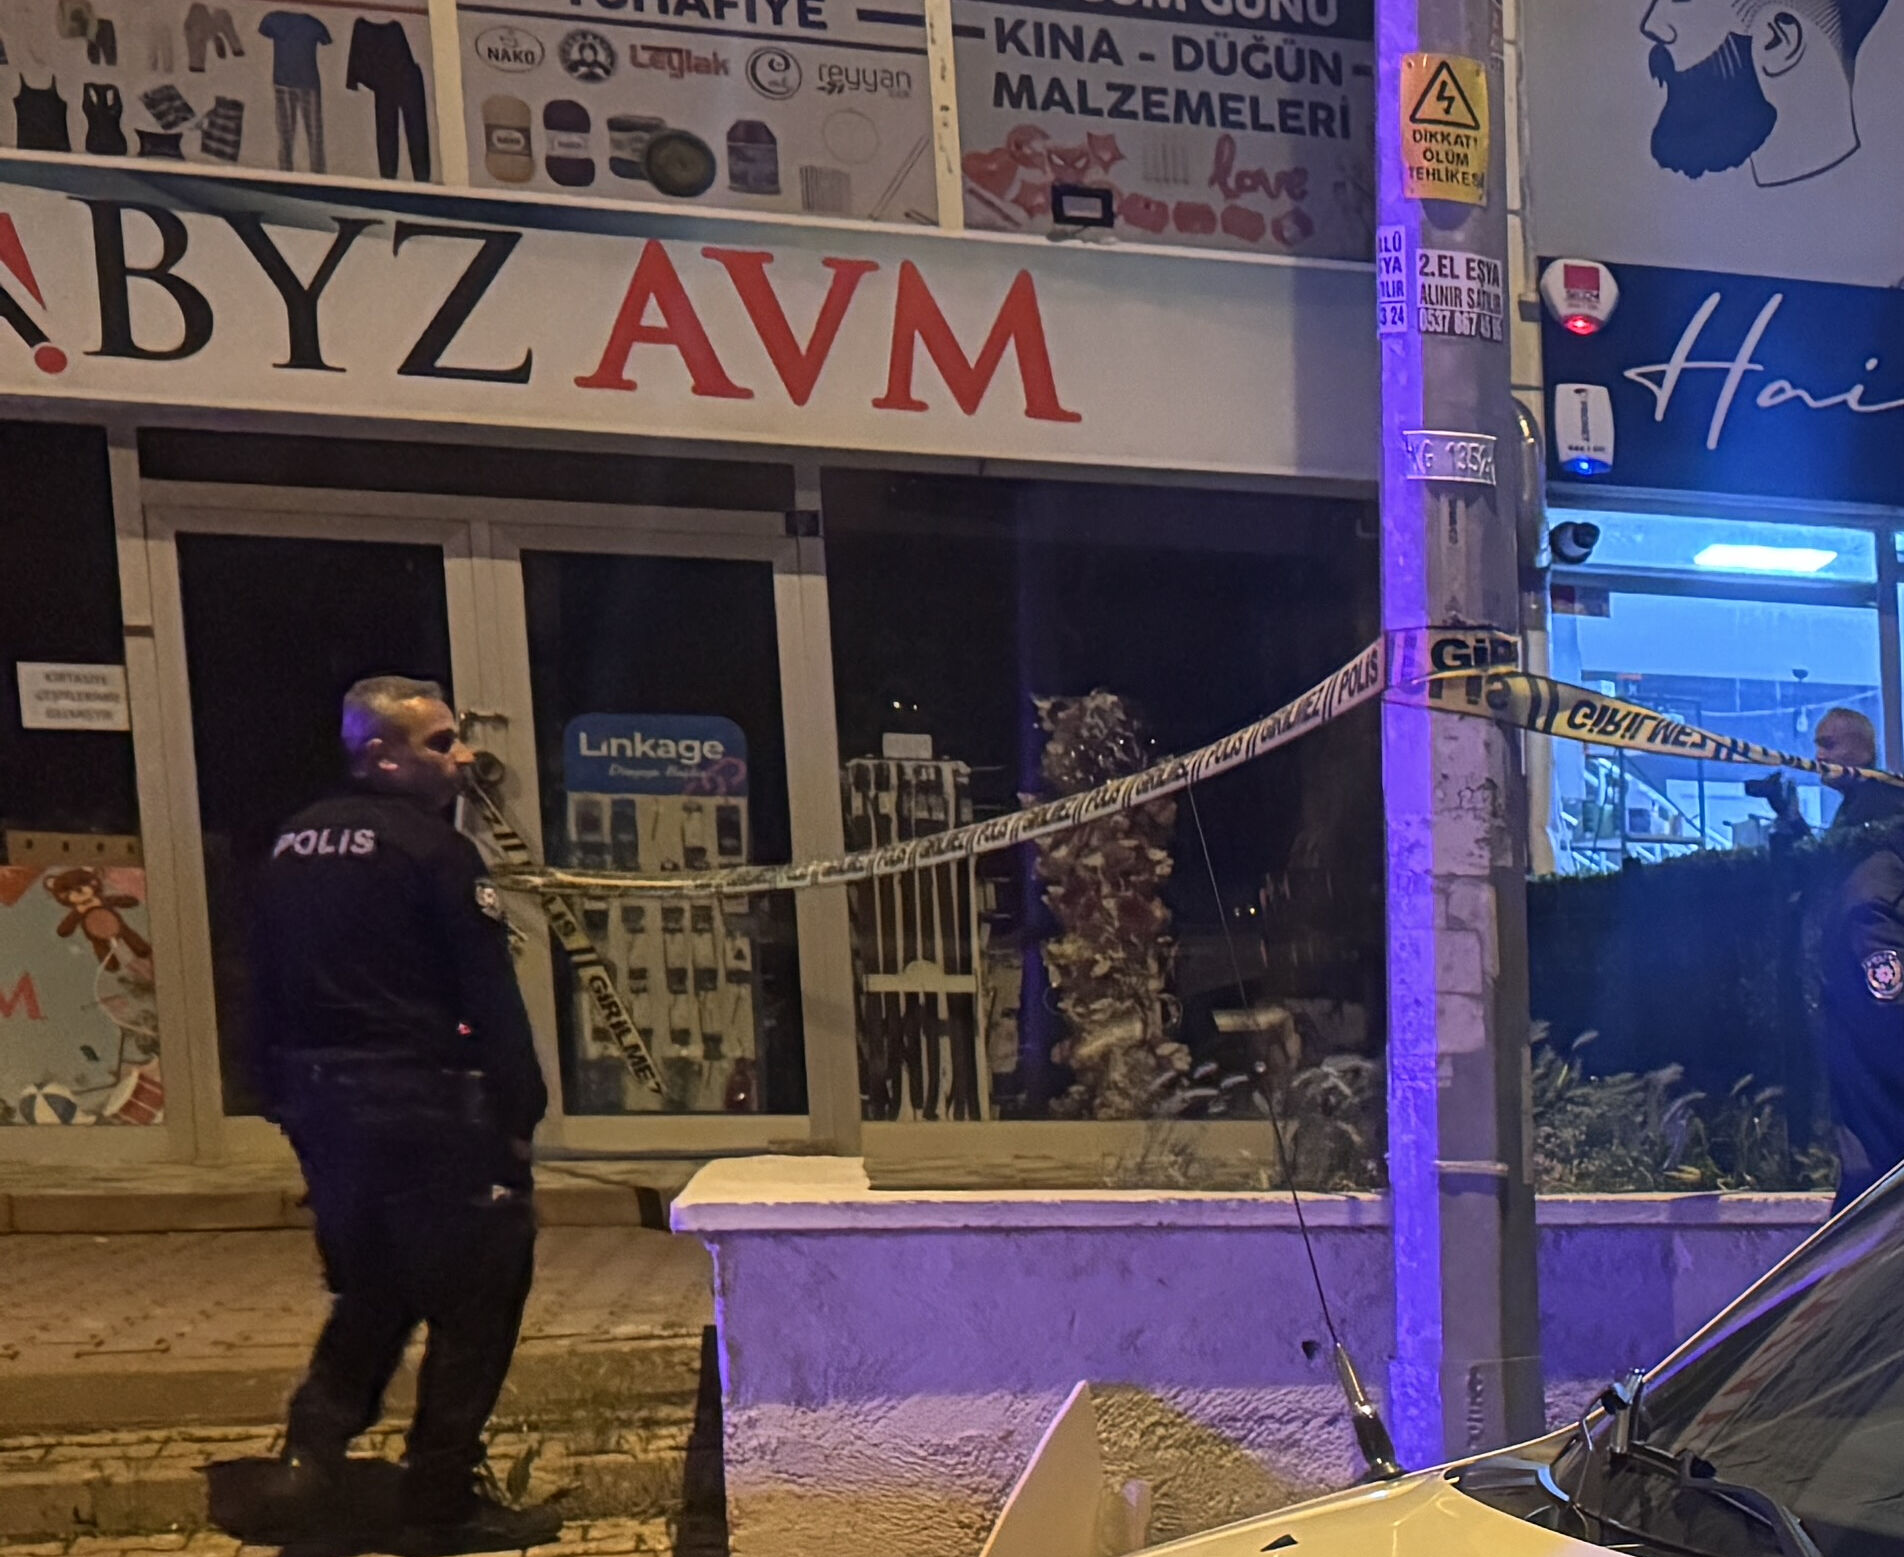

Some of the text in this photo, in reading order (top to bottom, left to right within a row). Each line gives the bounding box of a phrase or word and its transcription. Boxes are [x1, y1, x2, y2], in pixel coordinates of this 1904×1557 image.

[993, 17, 1124, 67] KINA
[1171, 31, 1343, 87] DÜĞÜN
[992, 71, 1352, 139] MALZEMELERİ
[573, 238, 1082, 424] AVM
